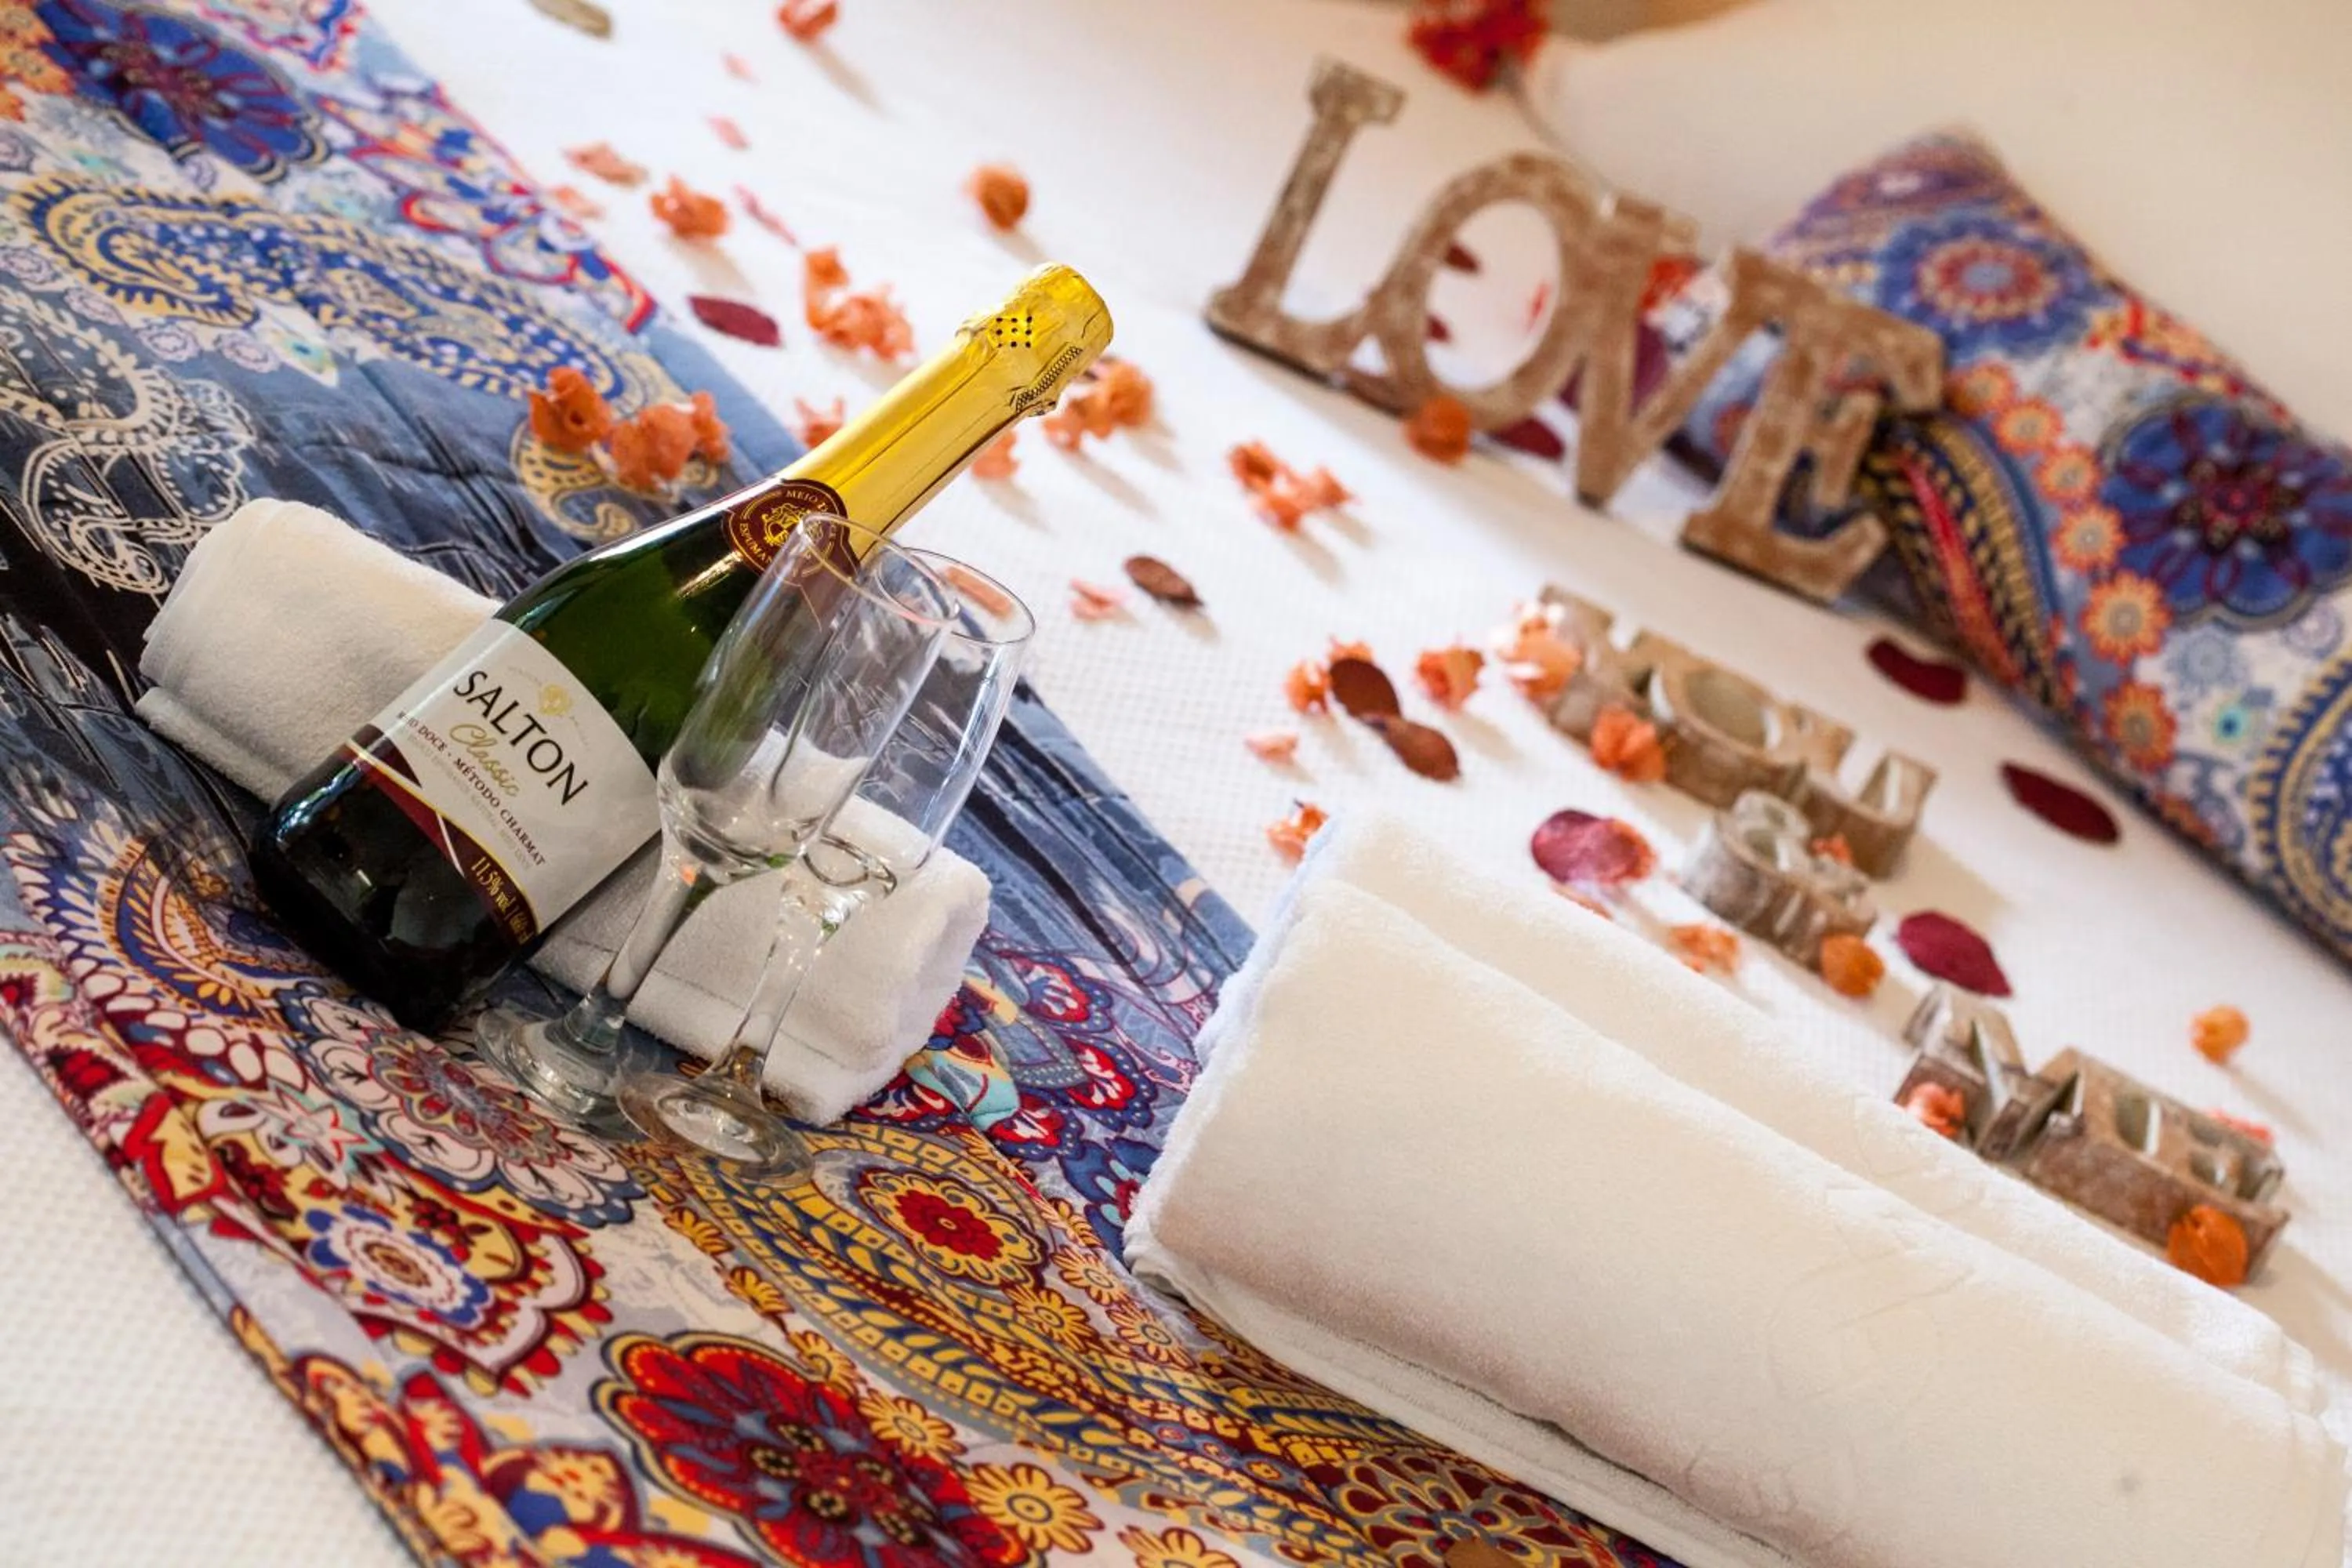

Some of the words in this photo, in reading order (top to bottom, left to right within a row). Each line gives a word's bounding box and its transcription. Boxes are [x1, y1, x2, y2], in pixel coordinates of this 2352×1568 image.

[1203, 51, 1944, 606] LOVE
[786, 490, 818, 503] MEIO
[418, 725, 447, 753] DOCE
[454, 757, 501, 808] MÉTODO
[499, 808, 546, 866] CHARMAT
[449, 724, 520, 797] Classic
[452, 670, 589, 806] SALTON
[1521, 583, 1938, 870] YOU
